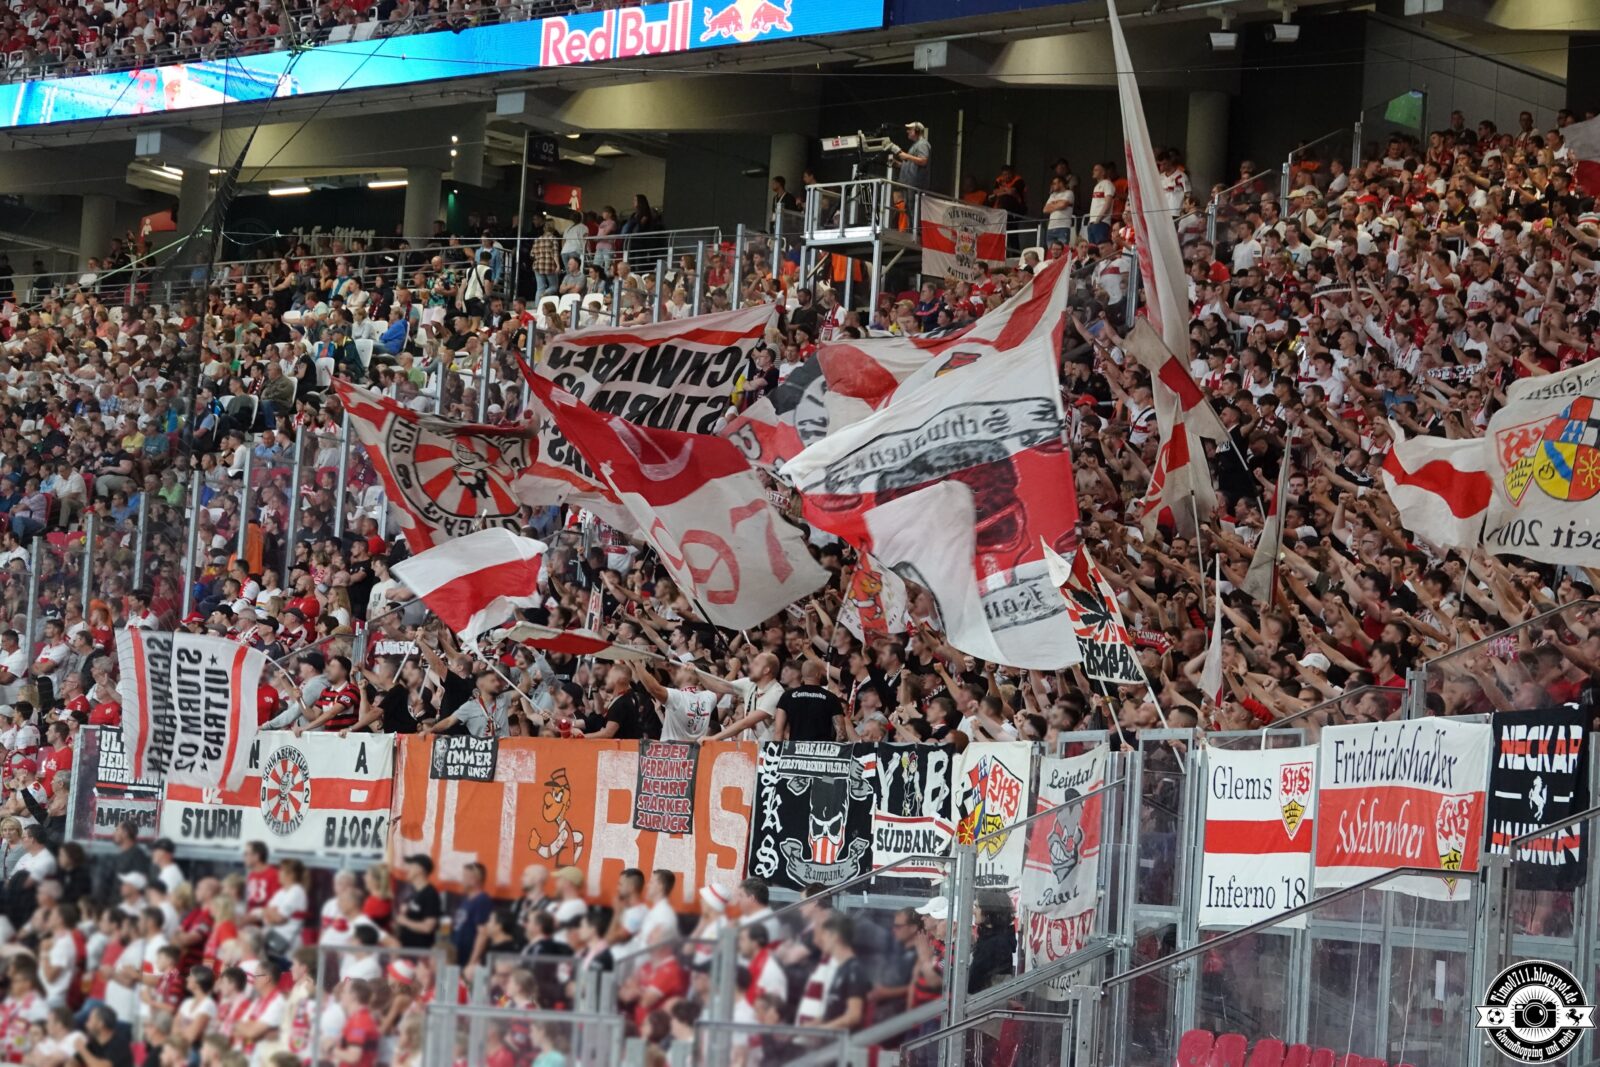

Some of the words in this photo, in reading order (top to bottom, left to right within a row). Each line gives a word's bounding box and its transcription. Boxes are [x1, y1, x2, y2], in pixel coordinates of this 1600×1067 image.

[540, 9, 615, 66] Red
[618, 0, 692, 54] Bull
[354, 741, 369, 775] A
[446, 749, 492, 767] IMMER
[449, 735, 466, 749] DU
[469, 737, 494, 751] BIST
[646, 743, 690, 759] JEDER
[1334, 724, 1458, 789] Friedrichshaller
[1498, 724, 1583, 774] NECKAR
[447, 765, 464, 776] BEI
[468, 766, 492, 778] UNS!
[640, 756, 694, 779] VERBANNTE
[1046, 758, 1097, 789] Leintal
[1213, 765, 1272, 800] Glems
[642, 777, 688, 796] KEHRT
[181, 807, 244, 838] STURM
[324, 816, 385, 849] BLOCK
[636, 810, 690, 832] ZURÜCK
[1206, 875, 1276, 909] Inferno
